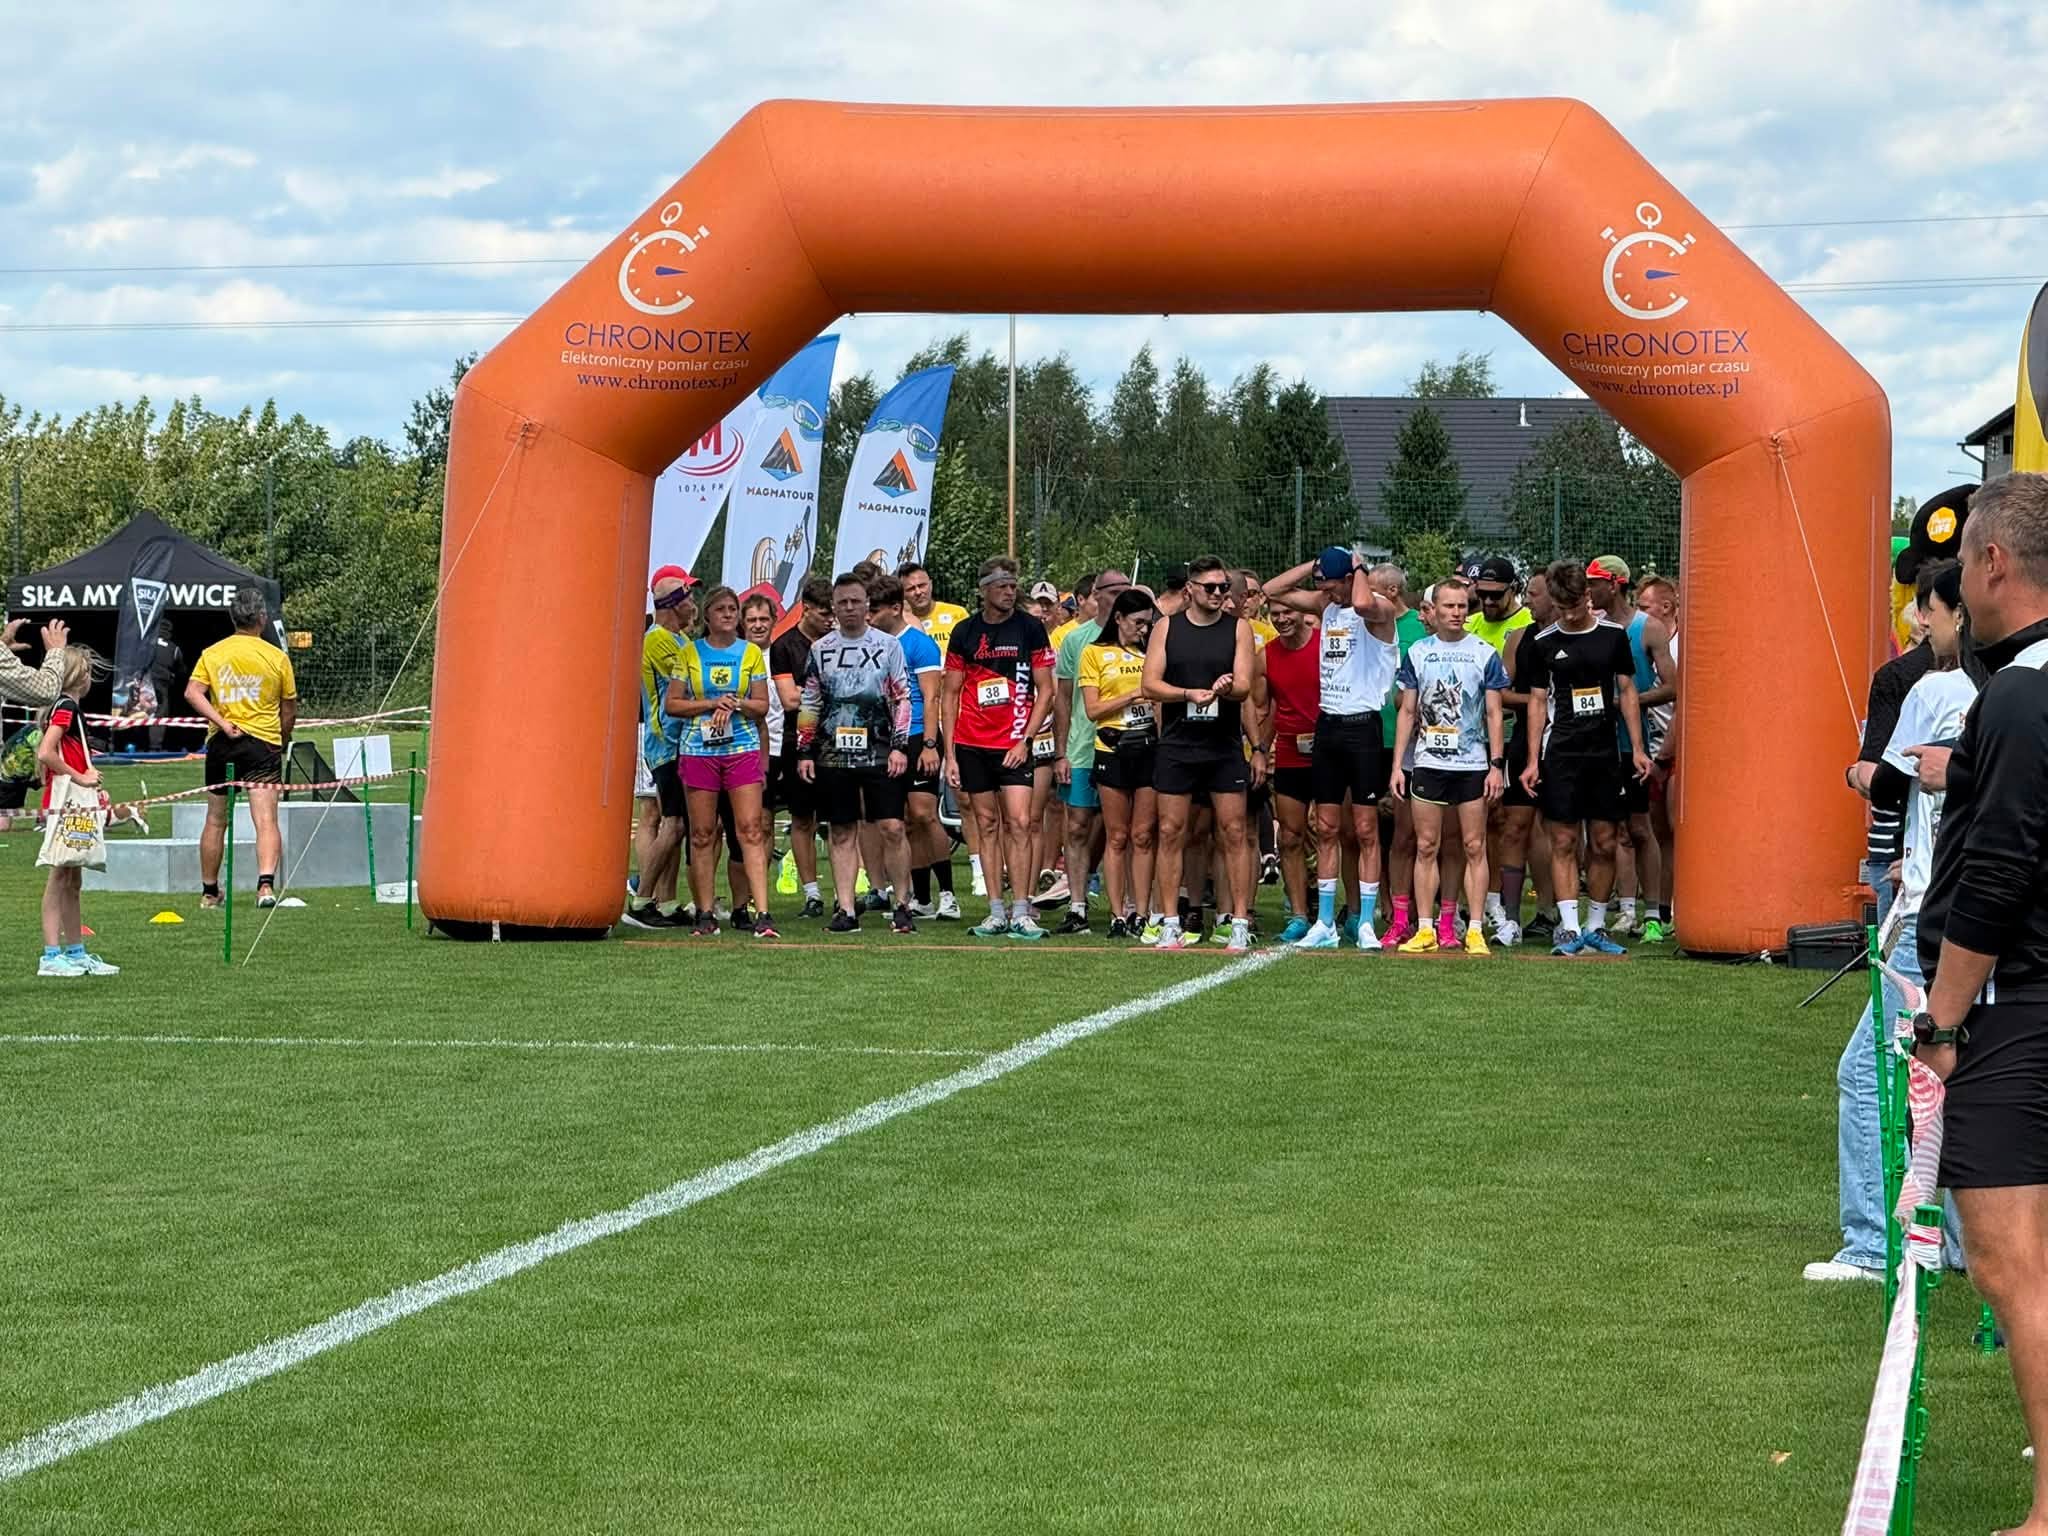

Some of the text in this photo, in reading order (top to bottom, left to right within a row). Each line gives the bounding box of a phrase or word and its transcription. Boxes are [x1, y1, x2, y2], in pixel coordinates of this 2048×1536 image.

[565, 322, 751, 353] CHRONOTEX
[1563, 330, 1748, 357] CHRONOTEX
[560, 350, 749, 373] Elektroniczny pomiar czasu
[1569, 357, 1750, 379] Elektroniczny pomiar czasu
[577, 373, 738, 392] www.chronotex.pl
[1589, 378, 1739, 398] www.chronotex.pl
[746, 487, 814, 501] MAGMATOUR
[858, 502, 927, 517] MAGMATOUR
[21, 585, 76, 607] SIŁA
[1329, 637, 1341, 650] 83
[1119, 665, 1144, 674] FAM
[985, 686, 1000, 699] 38
[1580, 696, 1596, 709] 84
[1131, 705, 1146, 718] 90
[841, 735, 862, 747] 112
[1039, 741, 1051, 752] 41
[1434, 735, 1449, 747] 55
